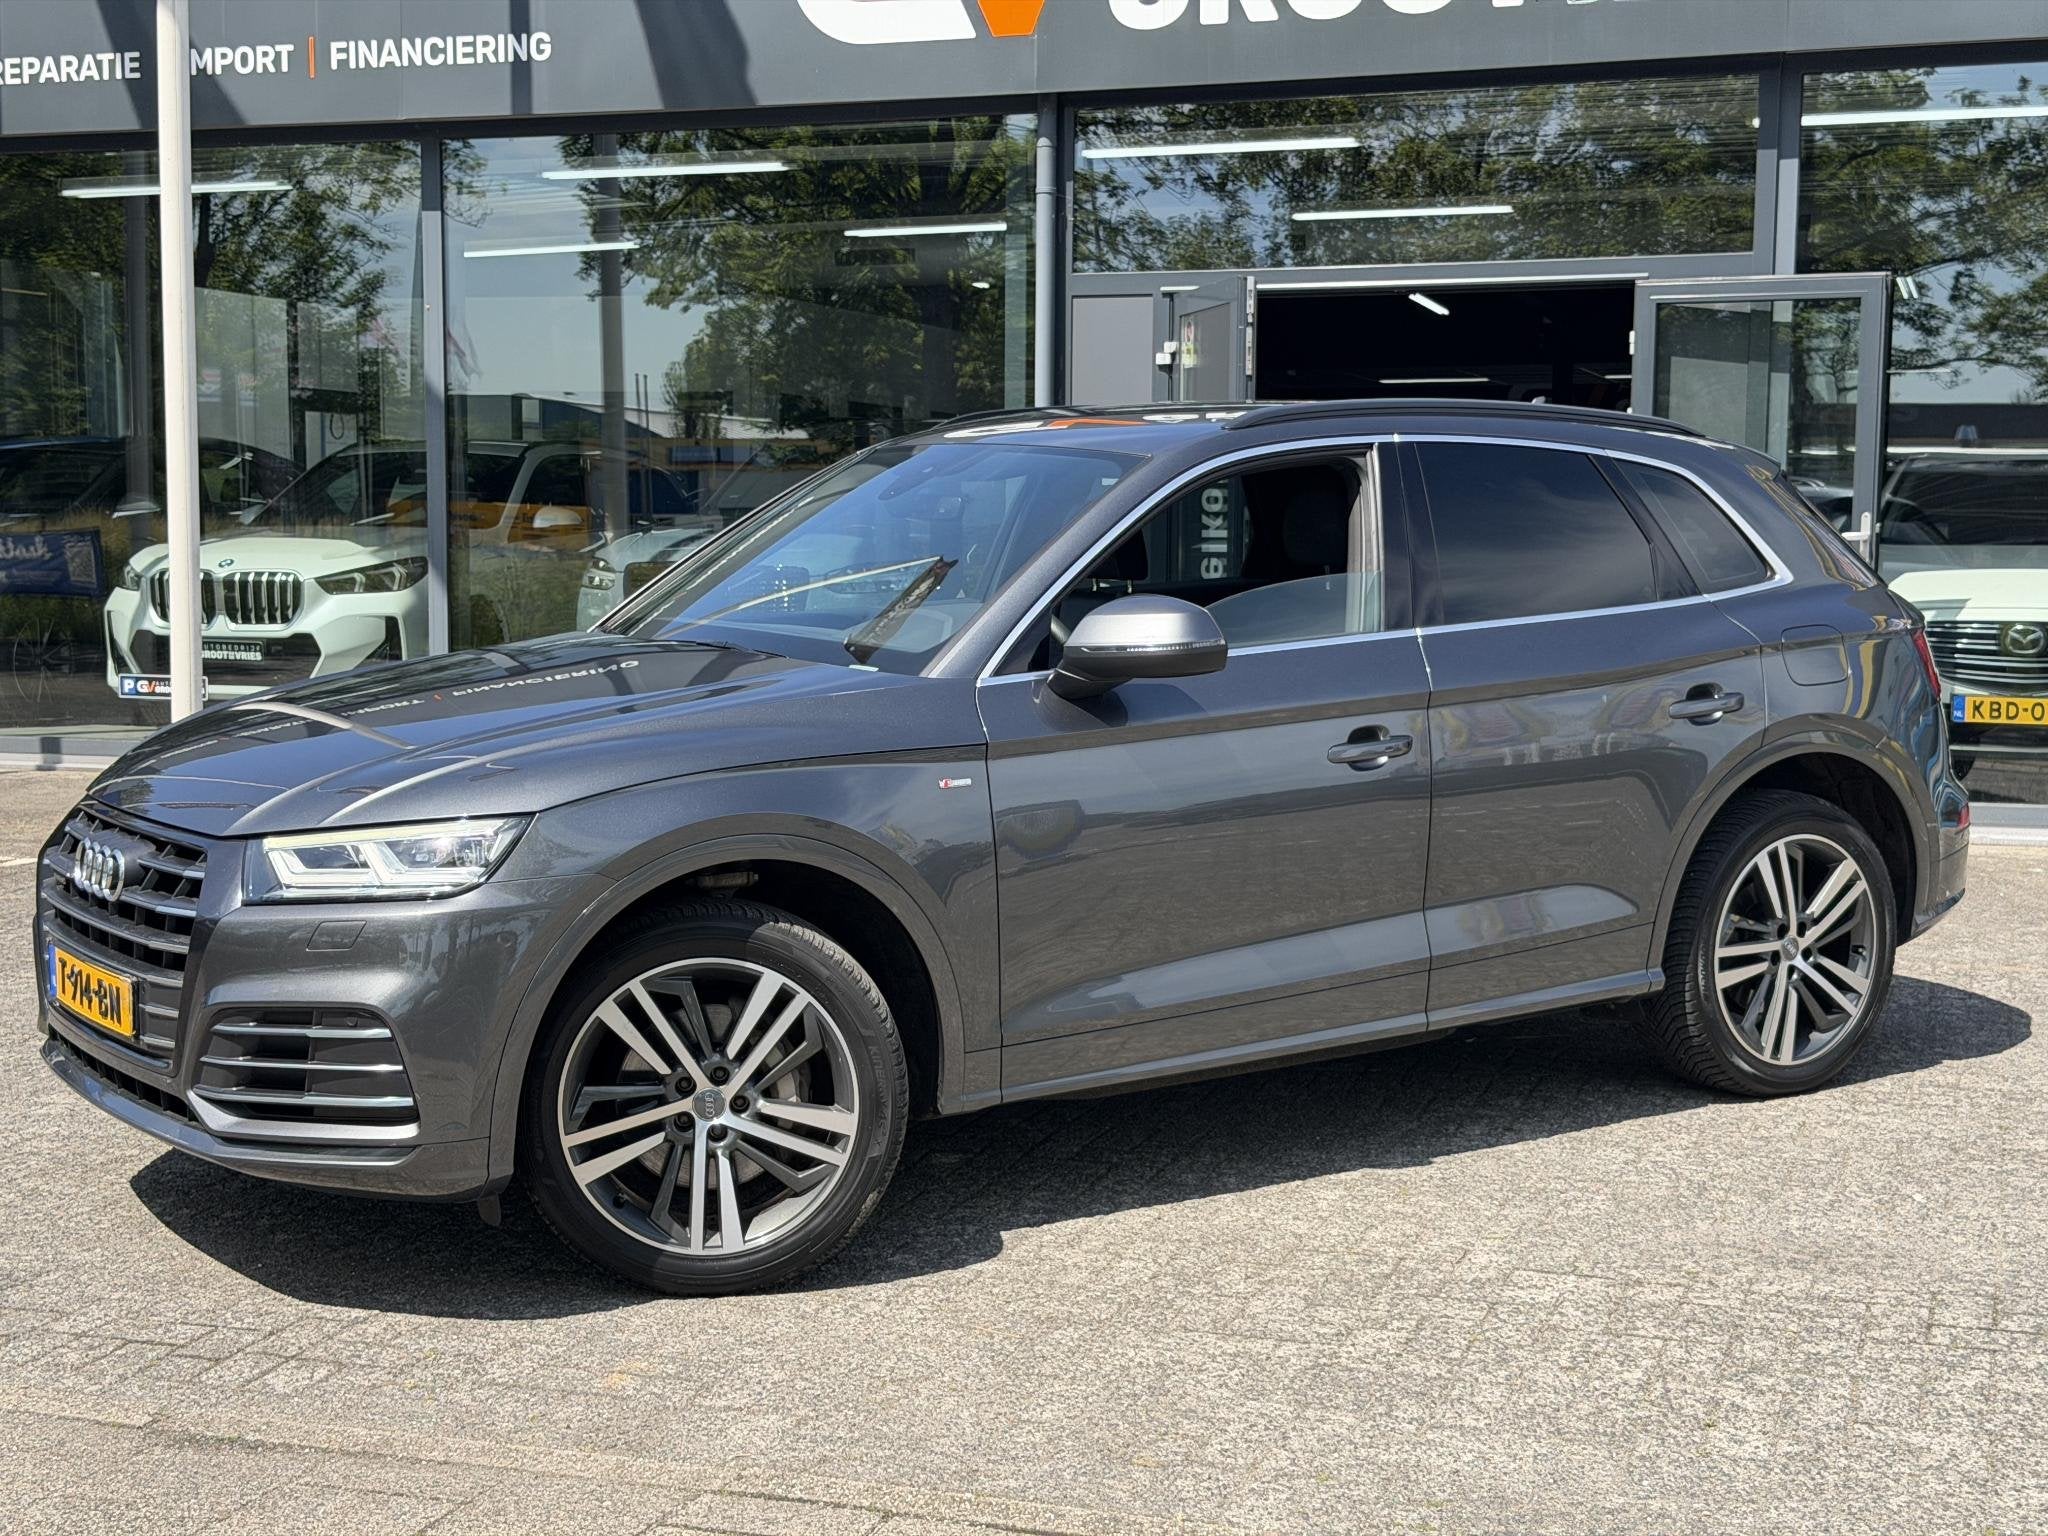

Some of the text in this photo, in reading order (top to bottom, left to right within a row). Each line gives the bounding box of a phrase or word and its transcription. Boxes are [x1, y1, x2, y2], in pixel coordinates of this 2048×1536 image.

[0, 31, 552, 85] EPARATIE MPORT FINANCIERING
[58, 956, 122, 1028] T-914-BN
